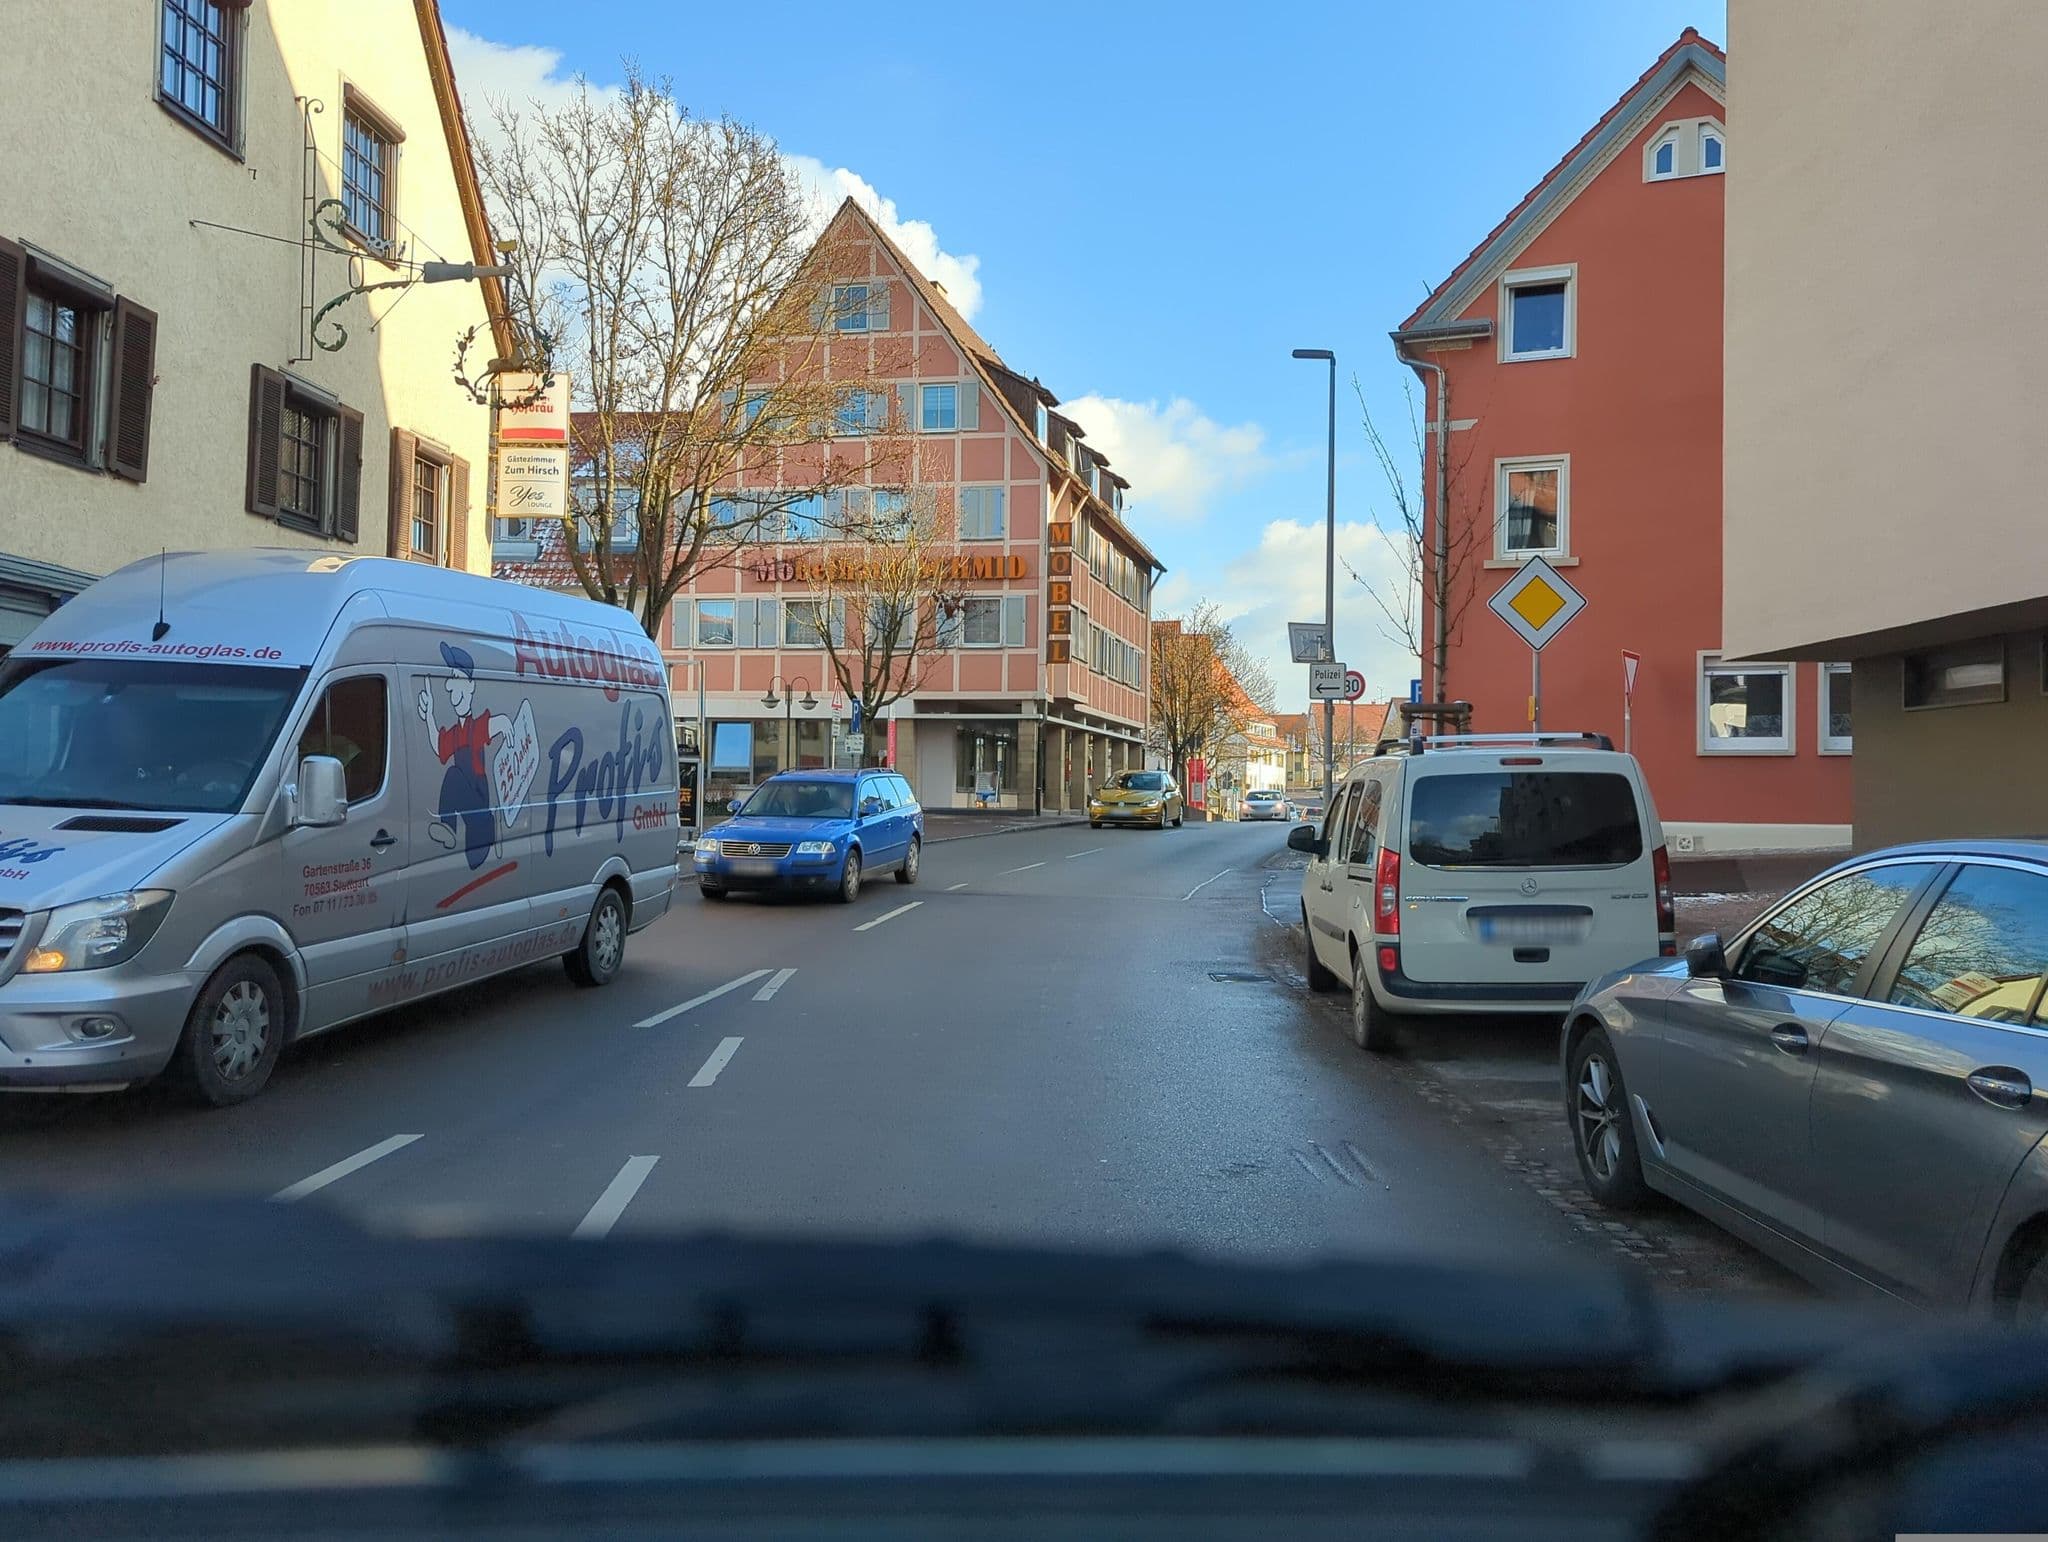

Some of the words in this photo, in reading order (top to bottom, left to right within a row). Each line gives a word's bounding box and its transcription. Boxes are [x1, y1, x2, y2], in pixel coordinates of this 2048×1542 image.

[507, 455, 556, 464] Gästezimmer
[504, 466, 525, 475] Zum
[527, 465, 560, 476] Hirsch
[509, 485, 545, 508] Yes
[31, 640, 282, 660] www.profis-autoglas.de
[513, 609, 663, 703] Autoglas
[1315, 669, 1341, 680] Polizei
[545, 698, 664, 858] Profis
[633, 801, 667, 830] GmbH
[303, 859, 359, 878] Gartenstraße
[333, 877, 369, 892] Stuttgart
[293, 903, 311, 917] Fon
[367, 922, 578, 994] www.profis-autoglas.de
